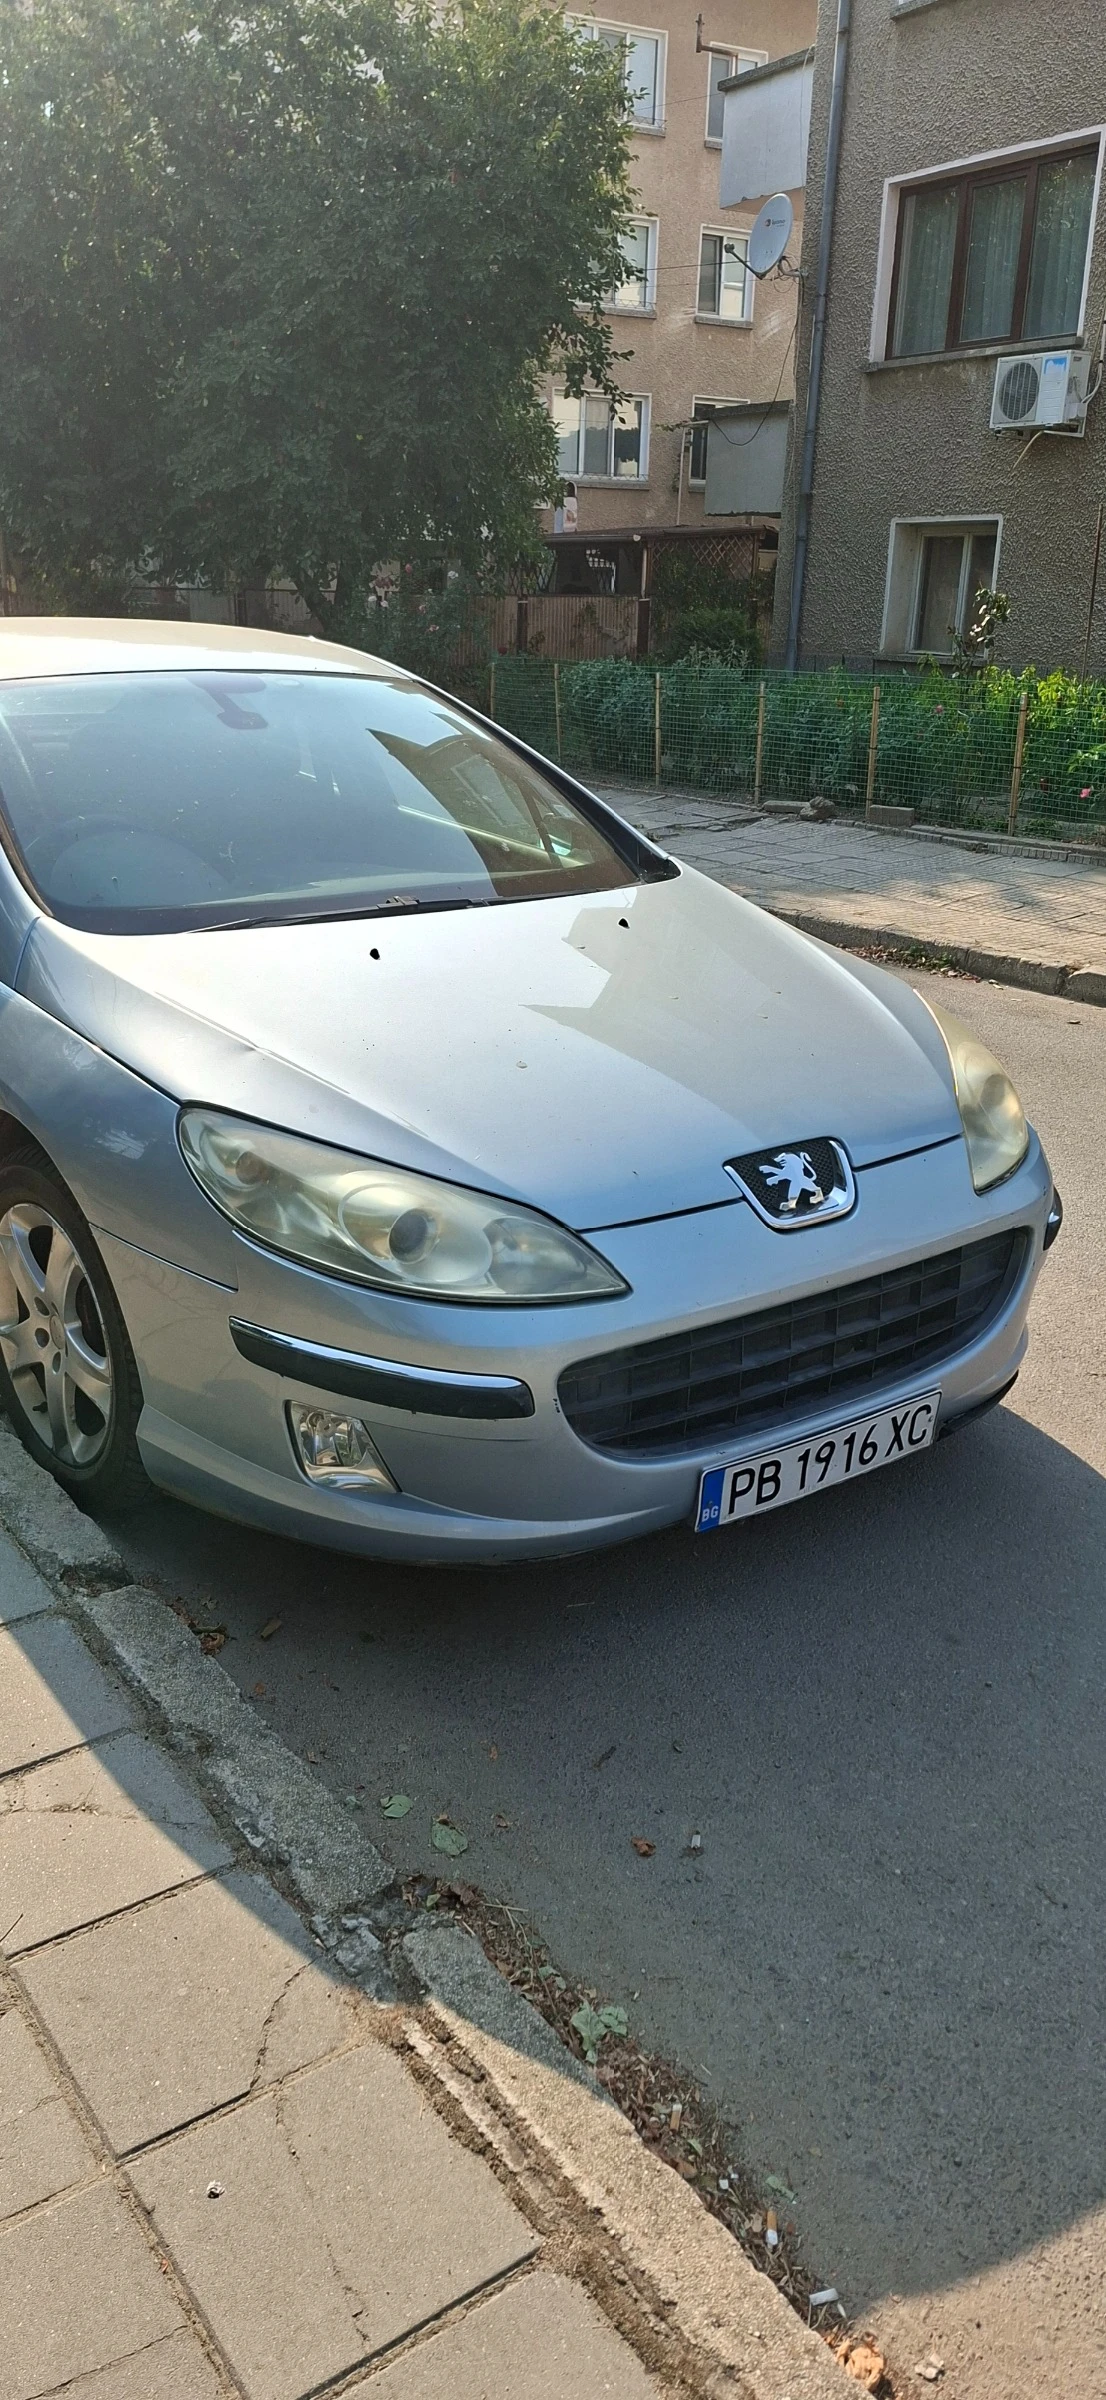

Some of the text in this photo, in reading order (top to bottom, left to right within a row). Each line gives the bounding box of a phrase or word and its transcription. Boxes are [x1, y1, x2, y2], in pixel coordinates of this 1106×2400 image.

[728, 1405, 931, 1513] PB 1916 XC
[702, 1506, 719, 1522] BG
